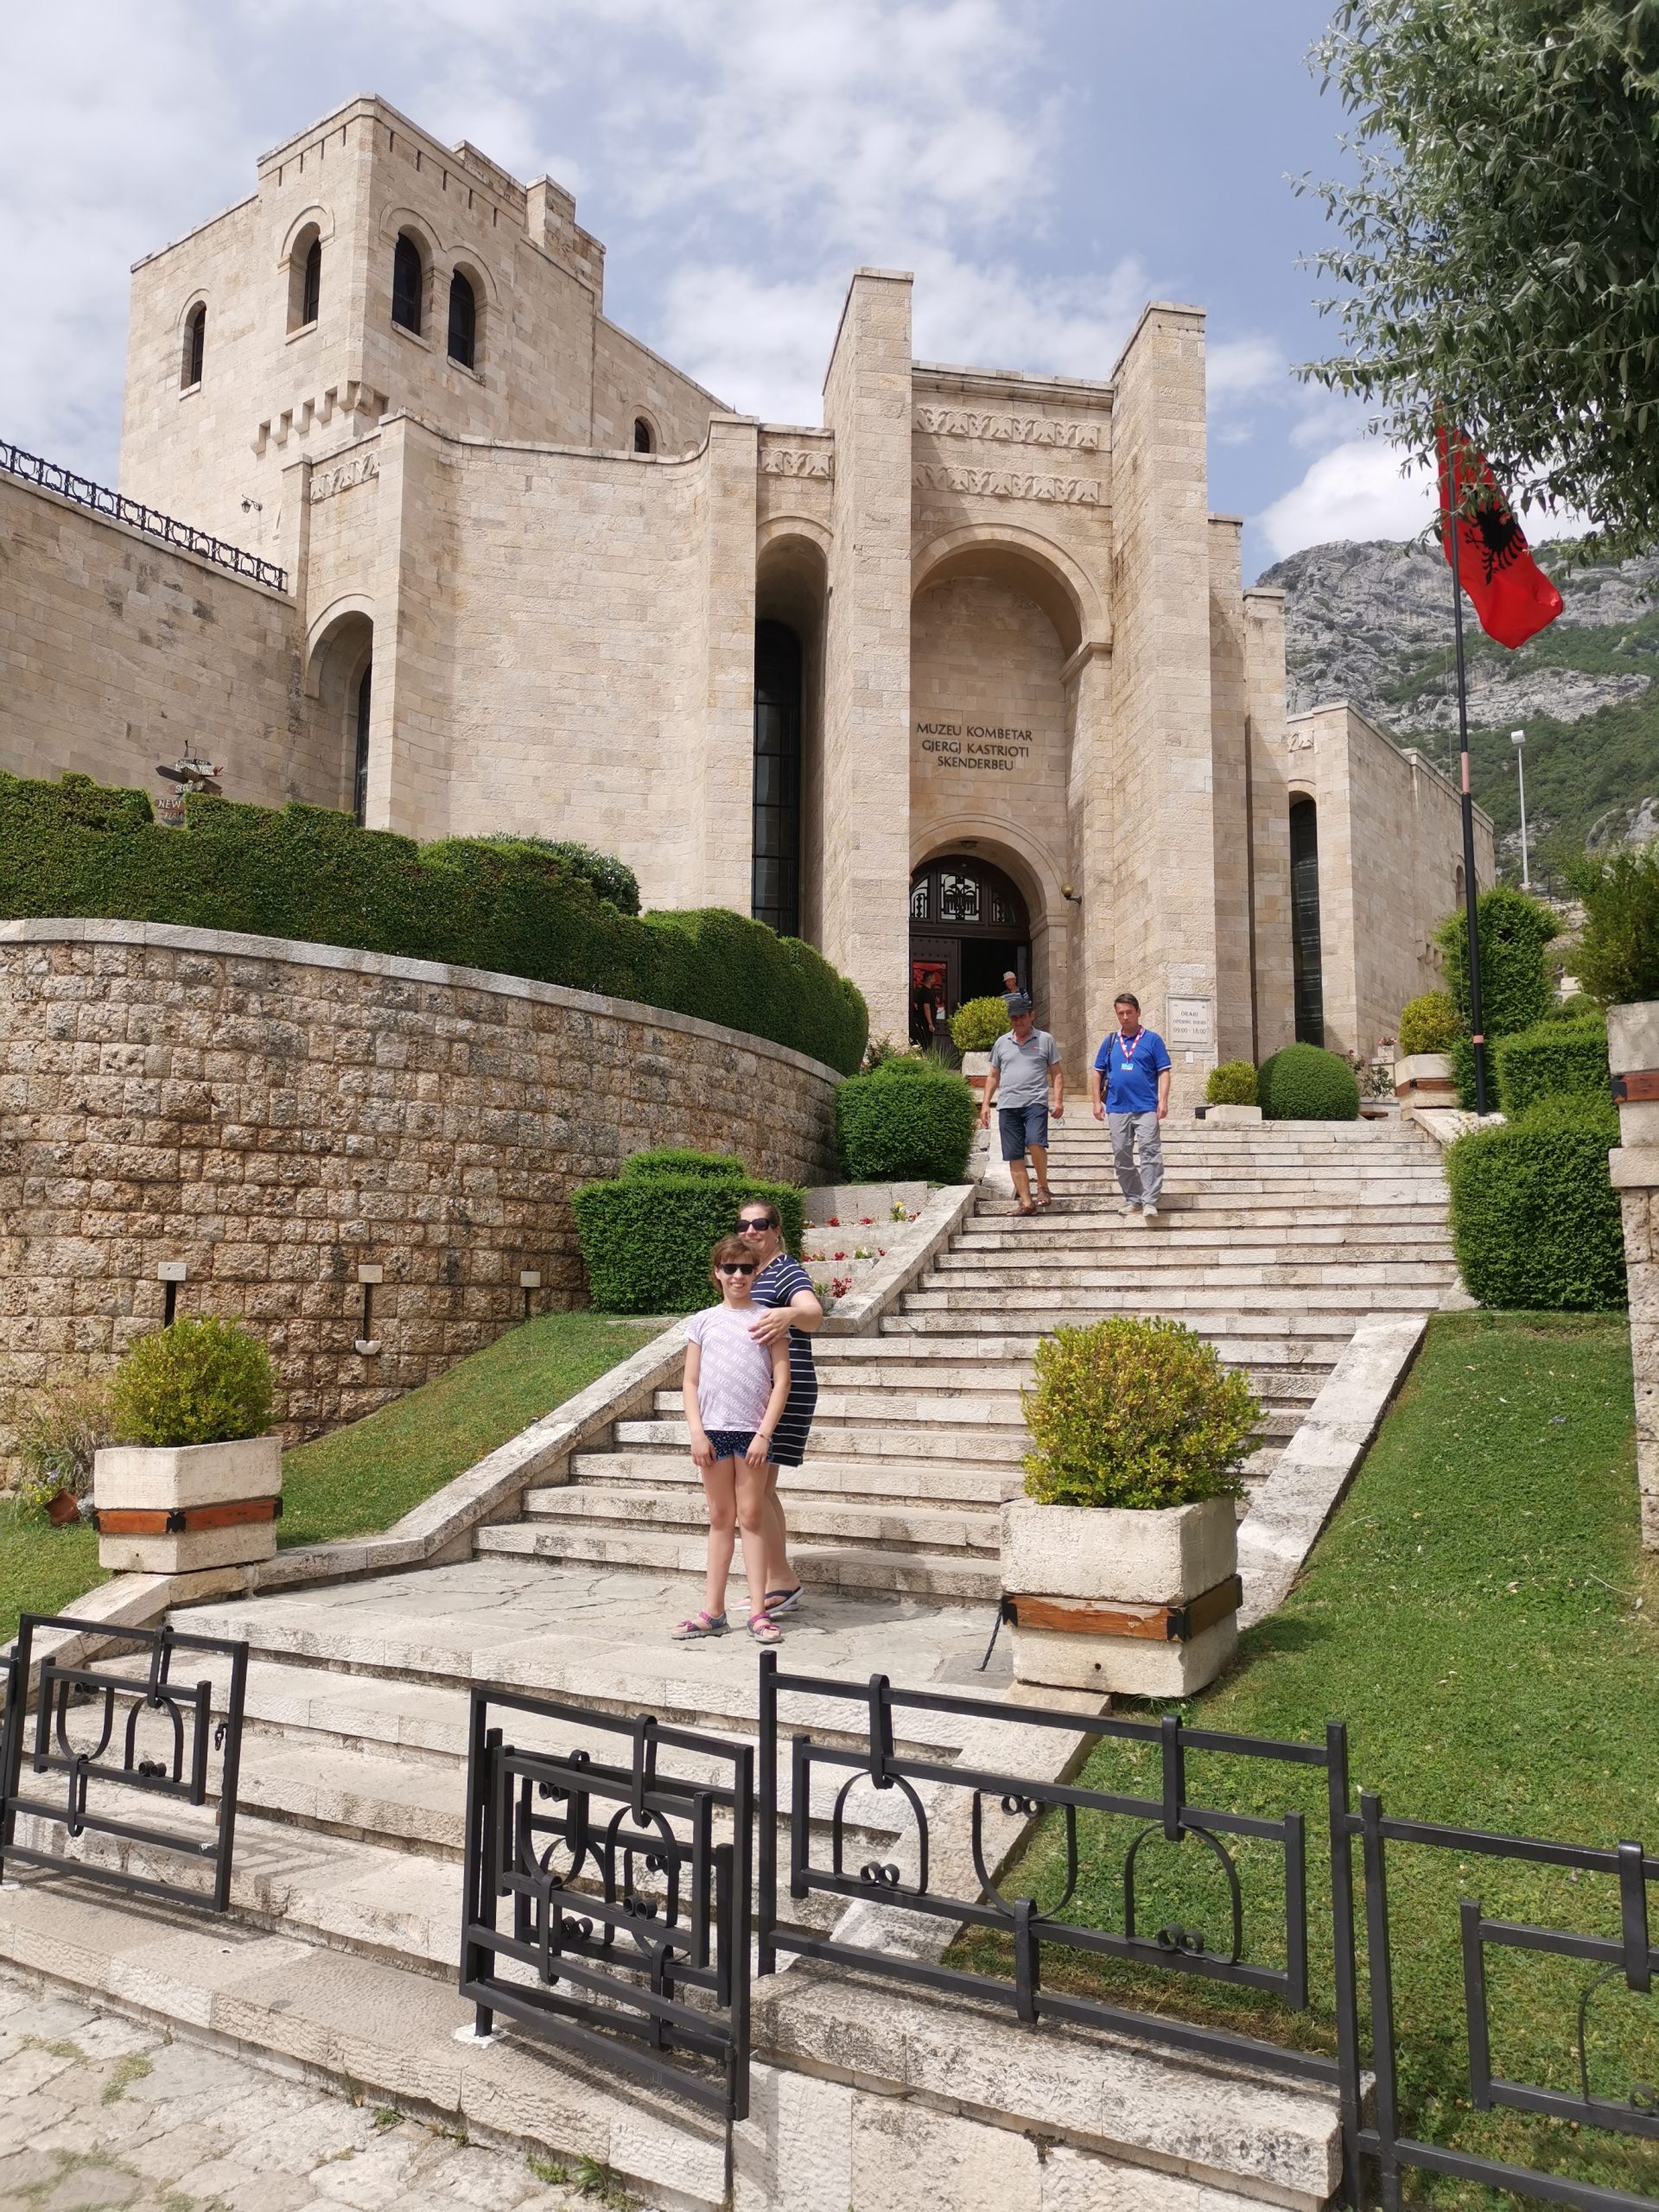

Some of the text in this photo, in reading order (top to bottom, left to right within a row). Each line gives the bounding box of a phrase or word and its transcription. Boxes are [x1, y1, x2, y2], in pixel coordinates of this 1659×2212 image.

[917, 722, 1033, 741] MUZEU KOMBETAR
[922, 740, 1029, 758] GJERGJ KASTRIOTI
[938, 756, 1014, 771] SKENDERBEU
[157, 799, 181, 809] NEW
